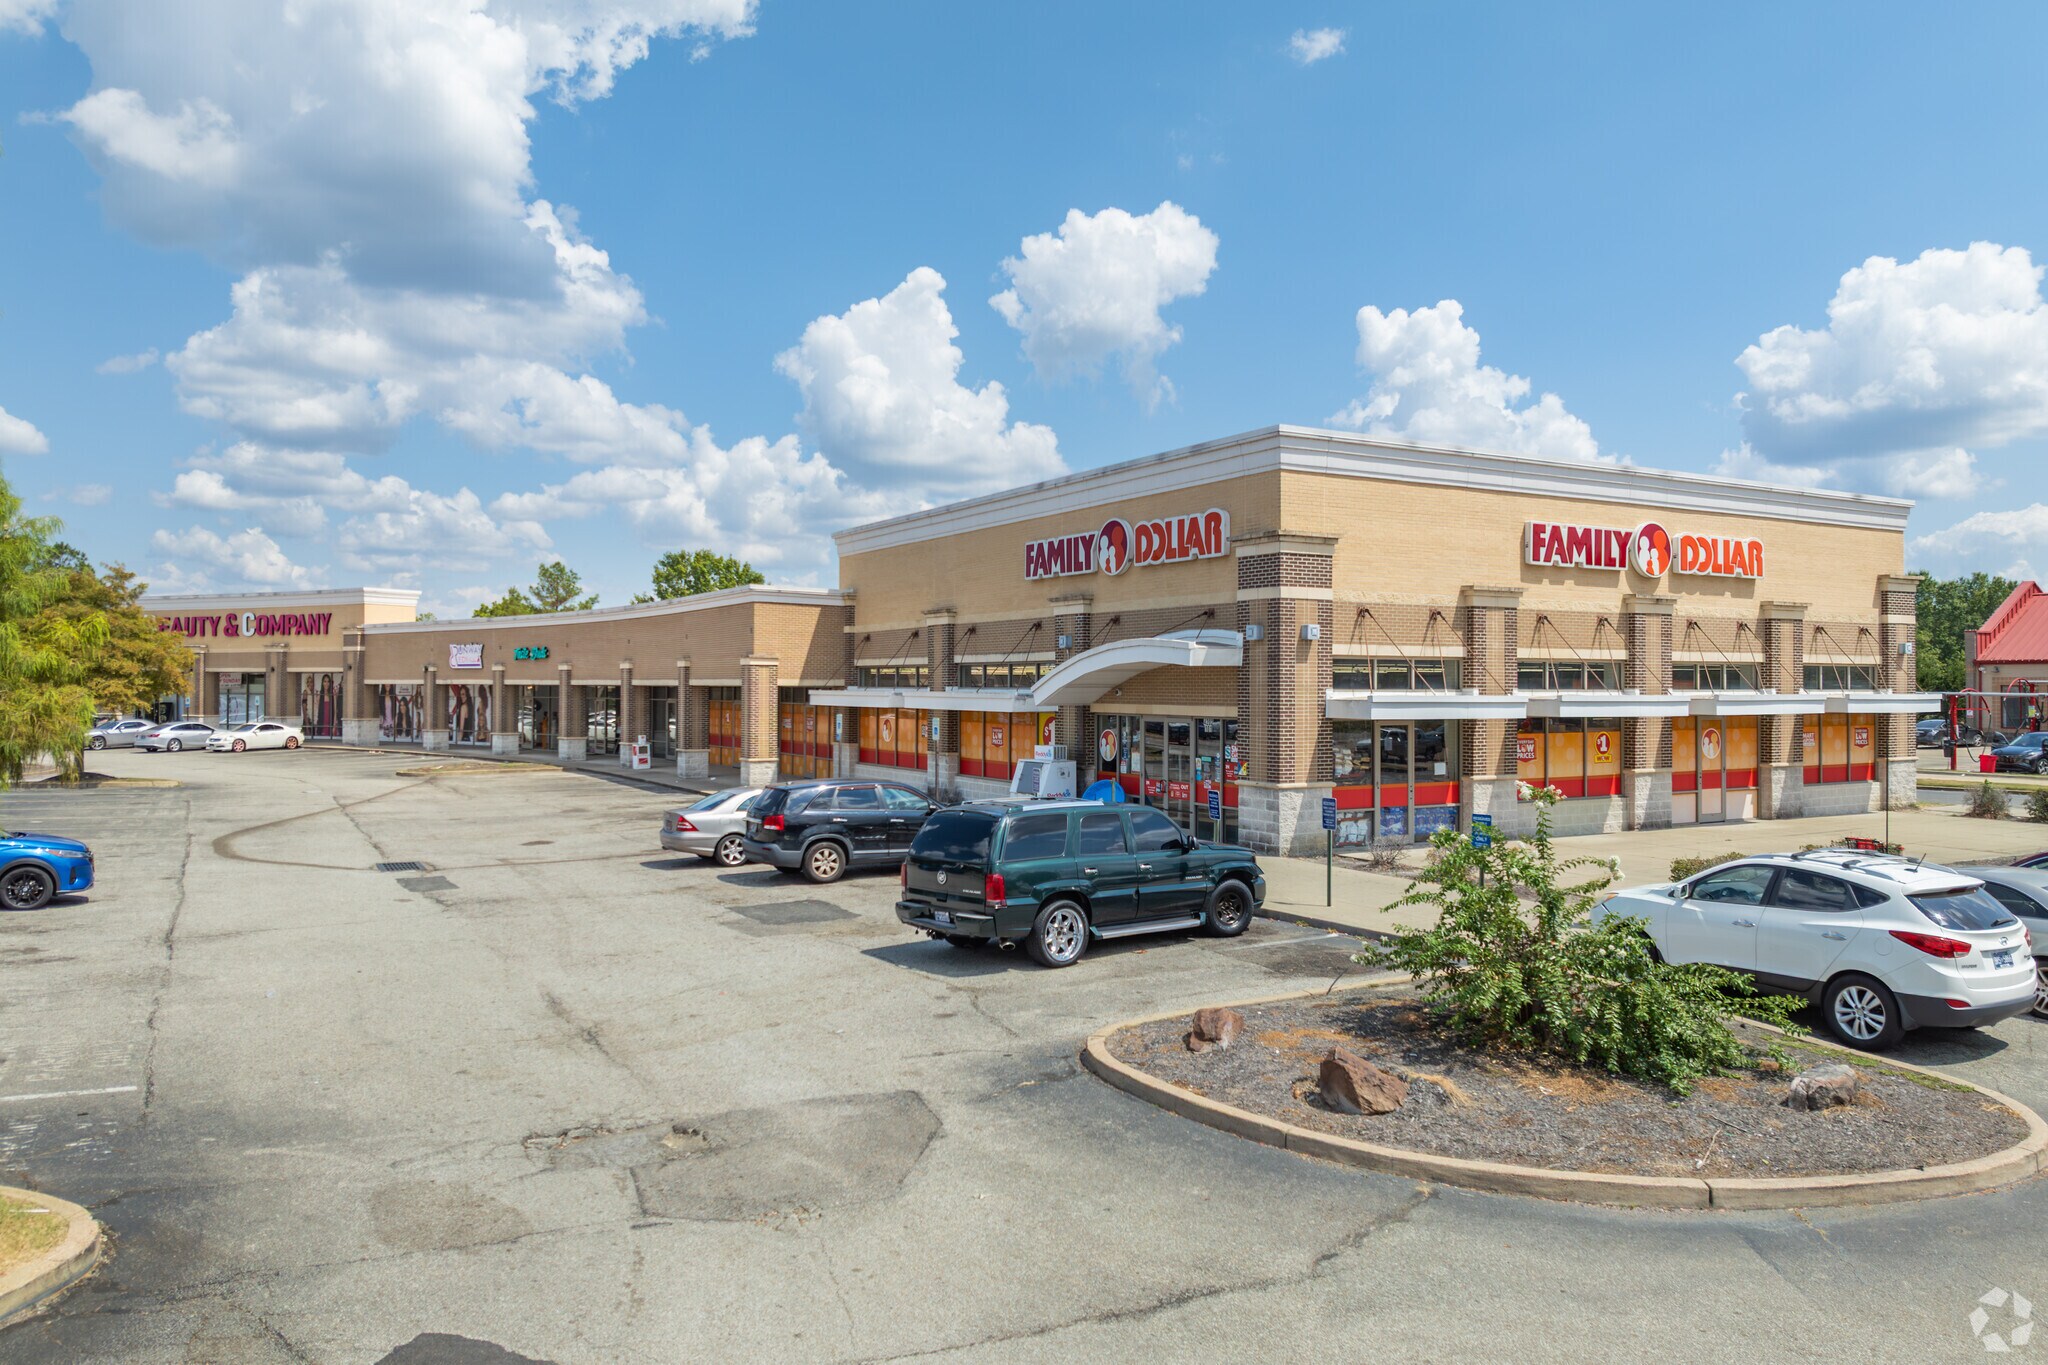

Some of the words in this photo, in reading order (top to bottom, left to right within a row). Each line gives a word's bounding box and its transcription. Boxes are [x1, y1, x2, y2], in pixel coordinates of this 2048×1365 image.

[1026, 533, 1096, 578] FAMILY
[1134, 511, 1223, 564] DOLLAR
[1532, 523, 1633, 568] FAMILY
[1680, 535, 1763, 577] DOLLAR
[158, 616, 221, 637] EAUTY
[223, 613, 239, 637] &
[242, 612, 332, 637] COMPANY
